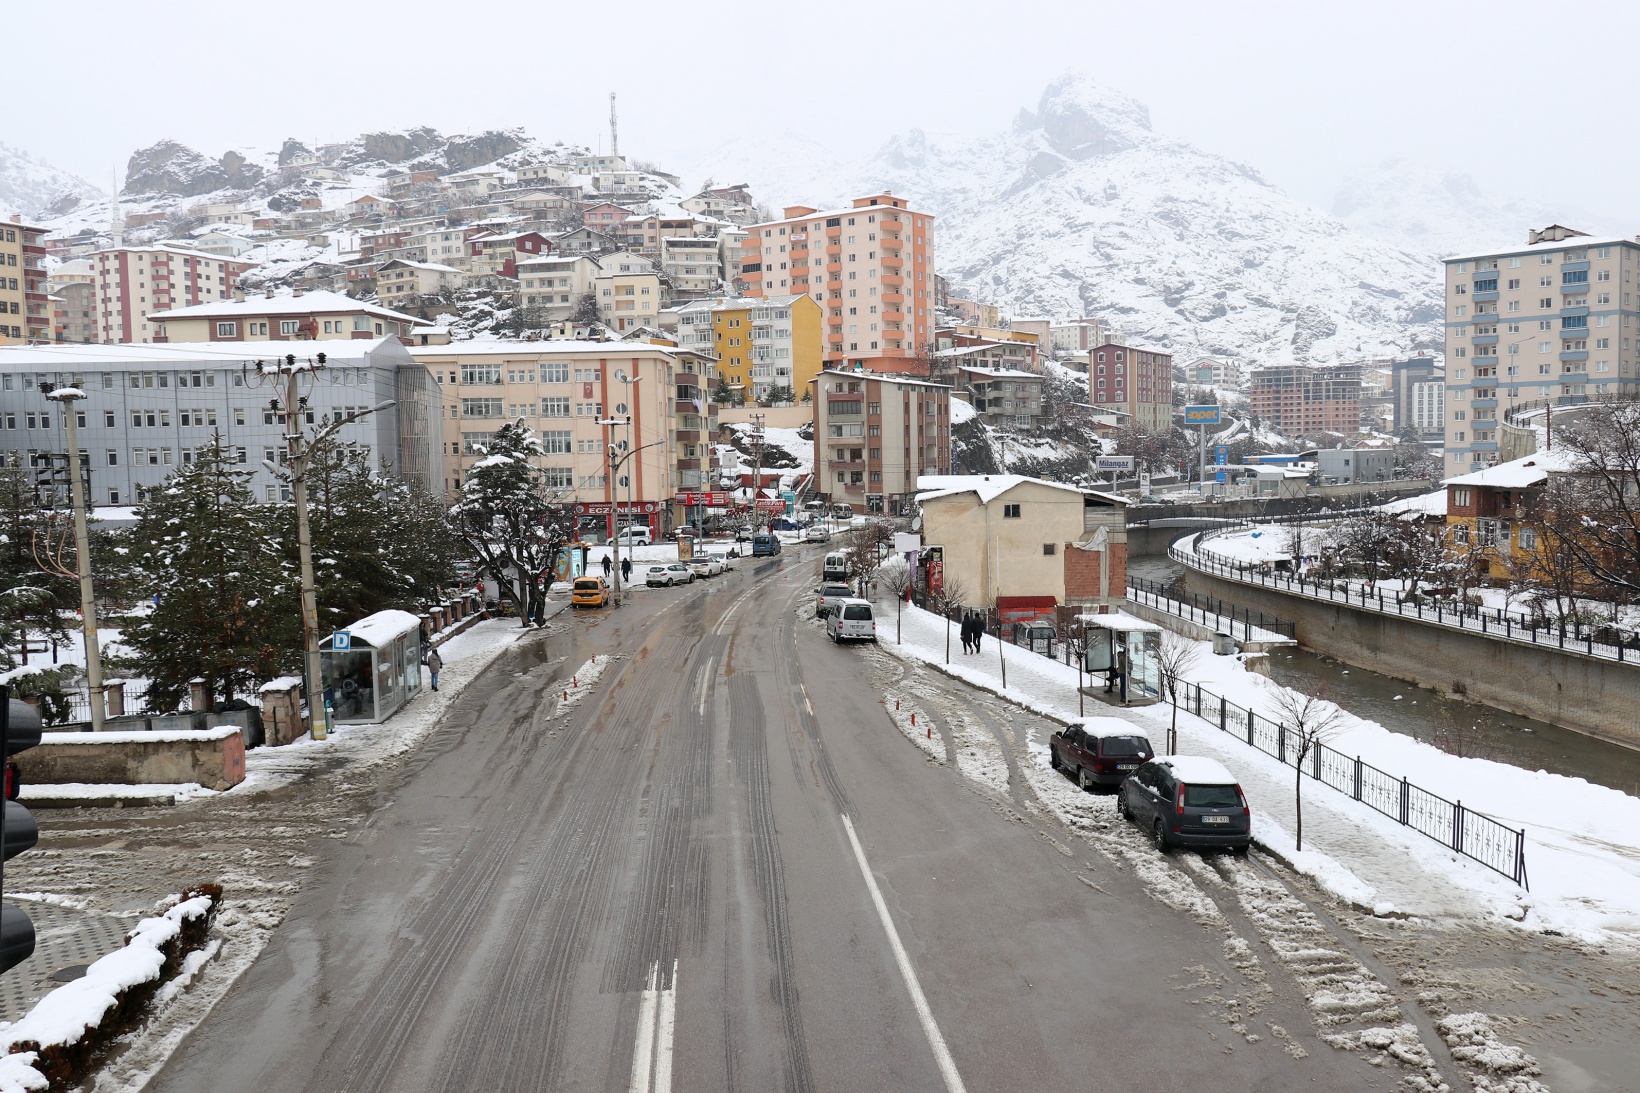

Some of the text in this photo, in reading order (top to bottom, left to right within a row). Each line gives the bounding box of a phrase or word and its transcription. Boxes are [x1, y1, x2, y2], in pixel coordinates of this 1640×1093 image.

[1099, 460, 1129, 468] Milangaz
[589, 506, 640, 514] ECZNESİ
[335, 634, 348, 647] D
